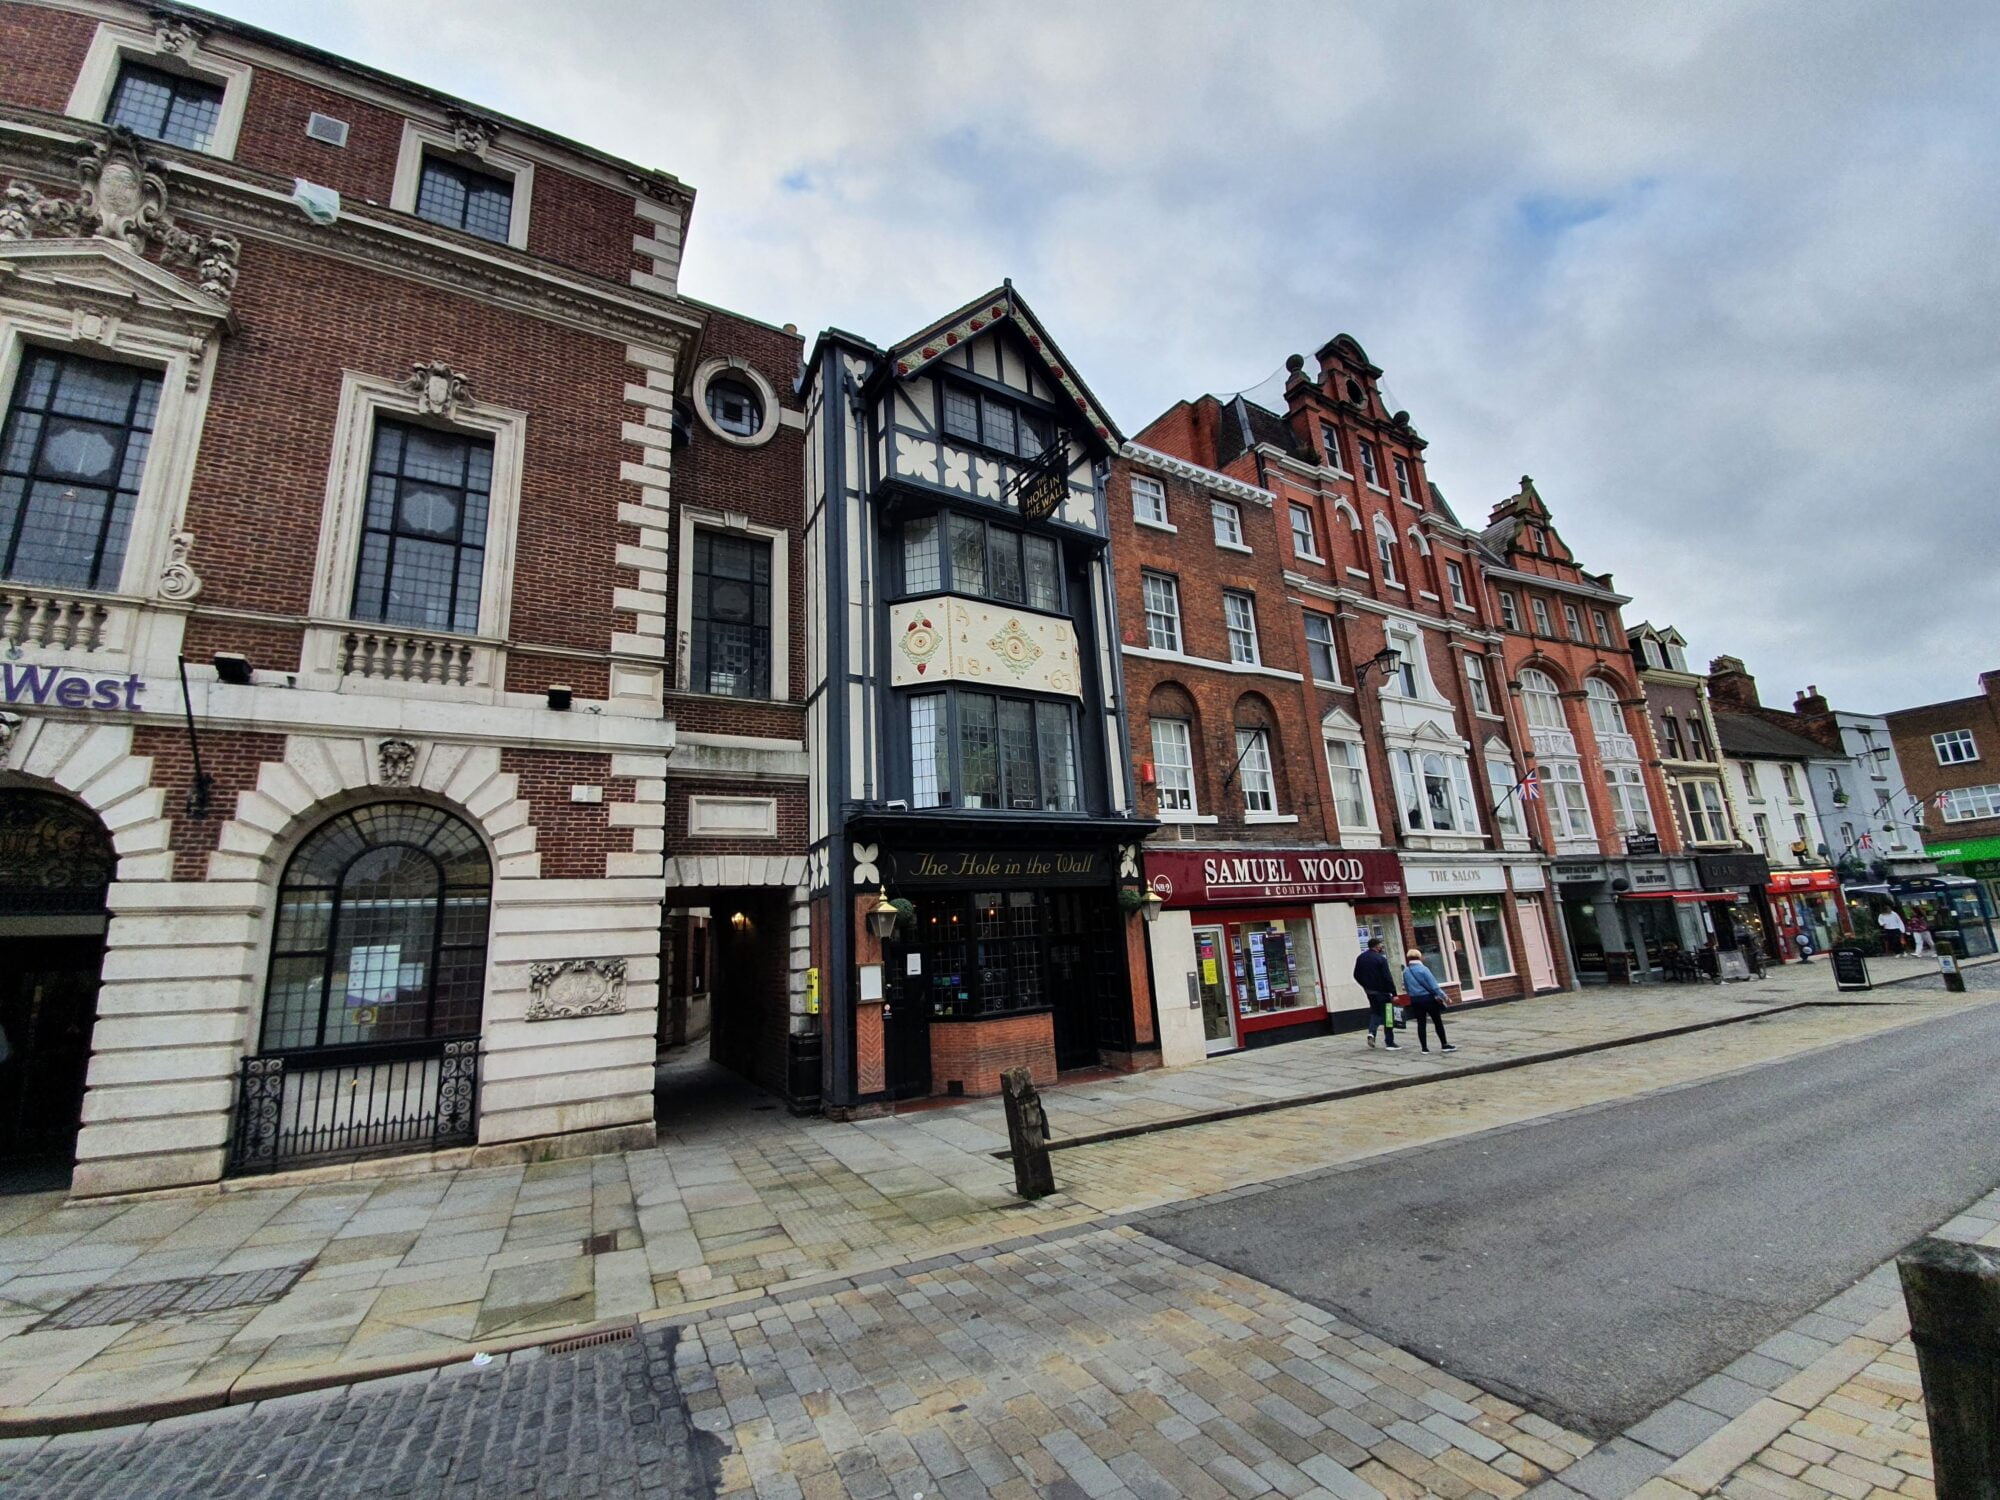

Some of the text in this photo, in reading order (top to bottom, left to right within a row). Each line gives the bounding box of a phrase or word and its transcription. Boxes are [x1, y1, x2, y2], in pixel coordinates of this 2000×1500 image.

[1026, 484, 1065, 521] THE WALL
[1027, 473, 1060, 508] HOLE IN
[3, 663, 146, 711] West
[909, 852, 1094, 876] The Hole in the Wall
[1933, 848, 1961, 858] HOME
[1205, 857, 1364, 884] SAMUEL WOOD
[1428, 869, 1481, 882] THE SALON
[1265, 885, 1320, 896] & COMPANY
